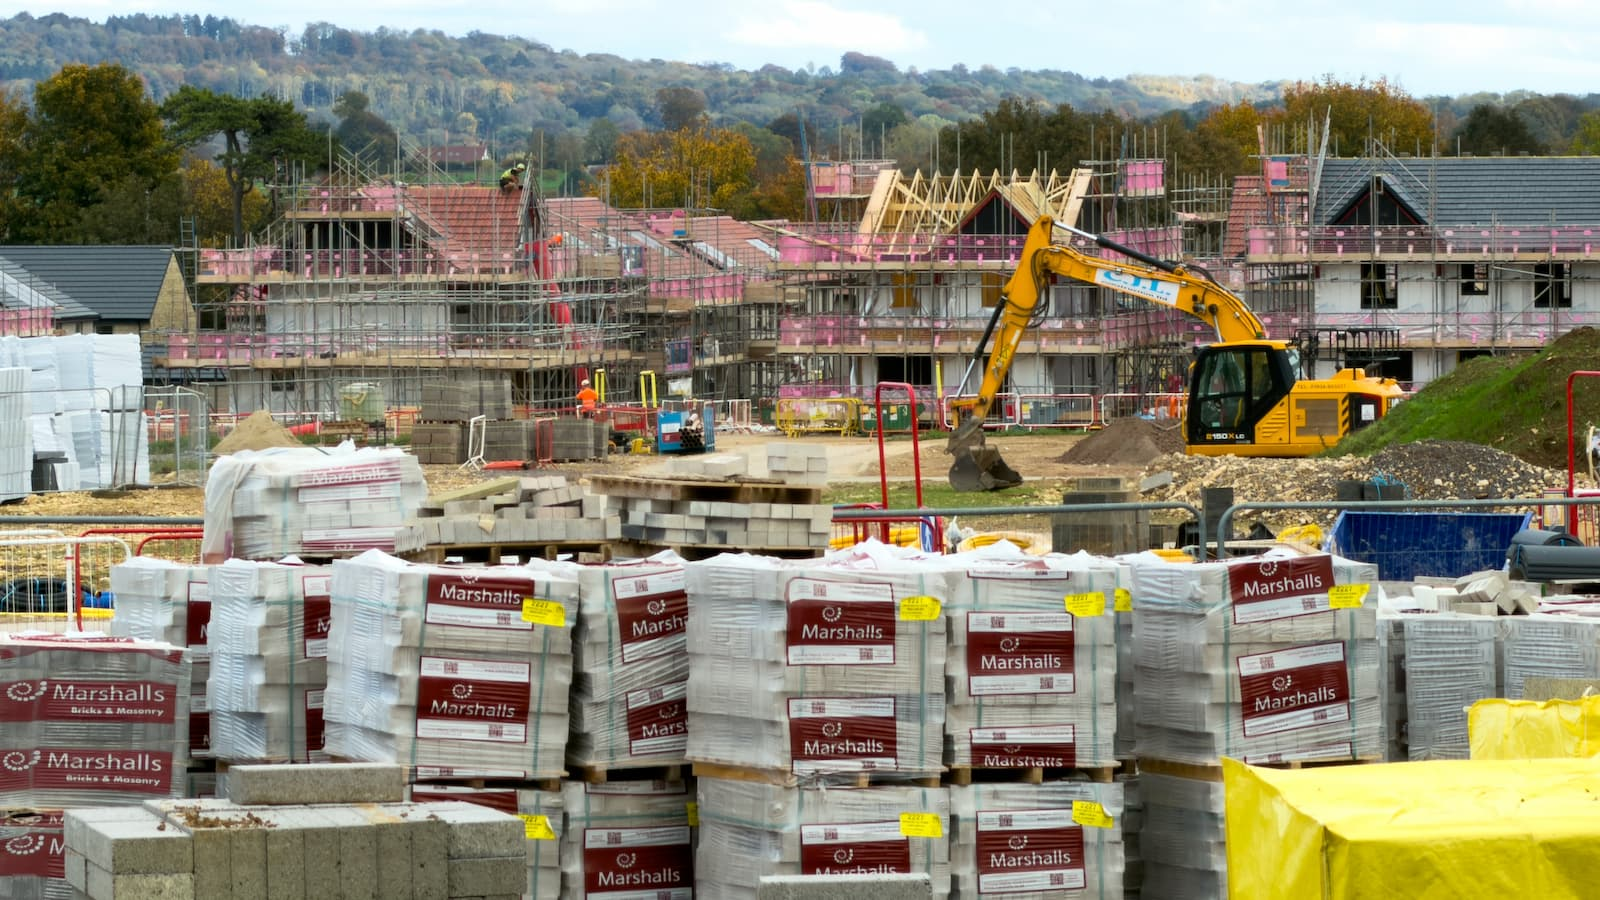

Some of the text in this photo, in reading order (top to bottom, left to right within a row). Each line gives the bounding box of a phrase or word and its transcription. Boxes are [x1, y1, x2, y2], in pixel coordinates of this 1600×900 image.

[440, 583, 521, 604] Marshalls
[1243, 574, 1322, 597] Marshalls
[801, 624, 883, 640] Marshalls
[981, 654, 1061, 670] Marshalls
[53, 684, 165, 702] Marshalls
[1255, 686, 1336, 712] Marshalls
[71, 706, 164, 717] Bricks & Masonry
[430, 700, 515, 718] Marshalls
[804, 739, 884, 755] Marshalls
[47, 753, 162, 771] Marshalls
[984, 755, 1063, 767] Marshalls
[66, 774, 160, 786] Bricks & Masonry
[990, 850, 1071, 868] Marshalls
[598, 868, 680, 886] Marshalls
